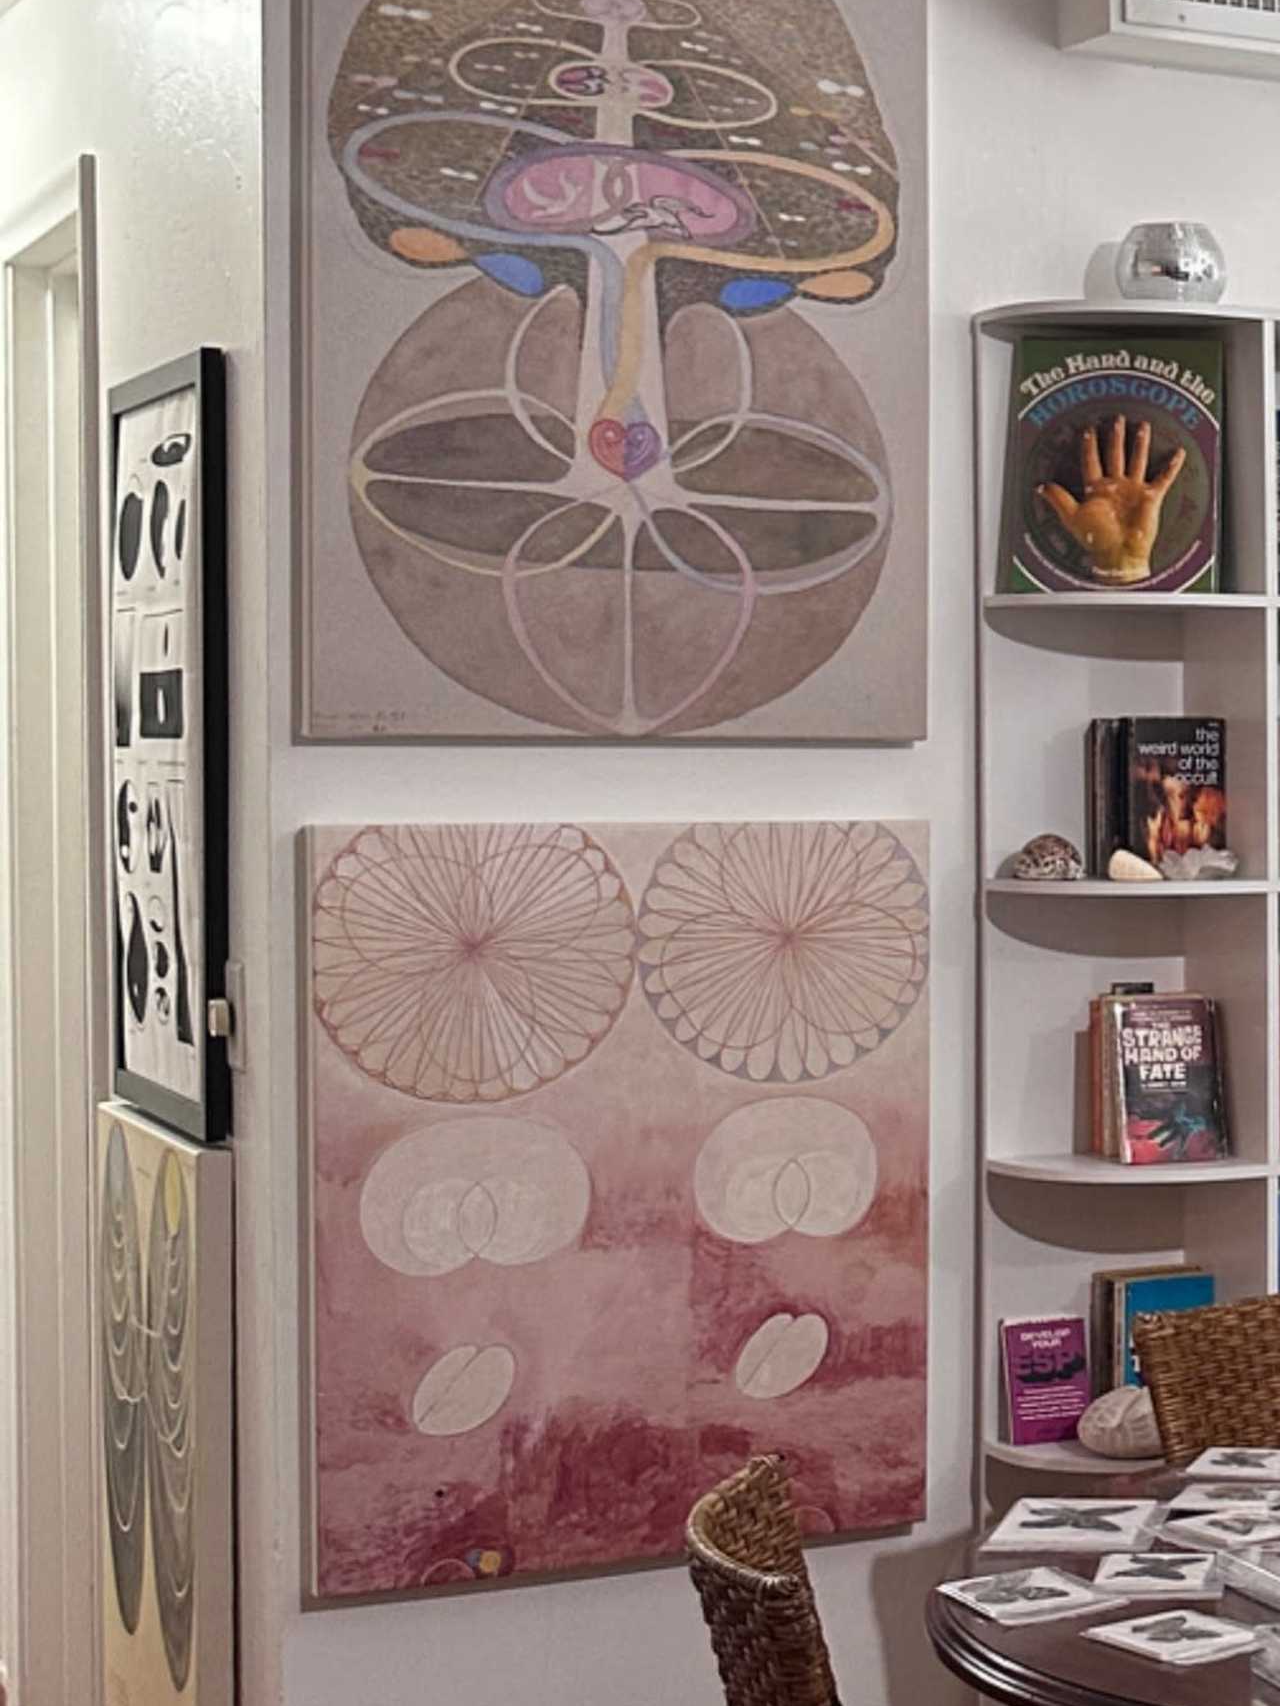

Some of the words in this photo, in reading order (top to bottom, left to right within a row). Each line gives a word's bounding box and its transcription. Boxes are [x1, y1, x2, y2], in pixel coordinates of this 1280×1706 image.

[1020, 366, 1066, 396] The
[1065, 349, 1131, 374] Hand
[1133, 353, 1179, 381] and
[1180, 370, 1216, 405] the
[1028, 377, 1200, 430] HOROSCOPE
[1195, 728, 1219, 742] the
[1138, 743, 1178, 756] weird
[1180, 743, 1219, 756] world
[1178, 757, 1193, 770] of
[1195, 757, 1218, 770] the
[1177, 772, 1218, 785] occult
[1122, 1024, 1203, 1048] STRANGE
[1123, 1047, 1179, 1067] HAND
[1180, 1044, 1203, 1062] OF
[1139, 1062, 1188, 1081] FATE
[1020, 1327, 1071, 1342] DEVELOP
[1032, 1338, 1062, 1349] YOUR
[1015, 1350, 1074, 1376] ESP
